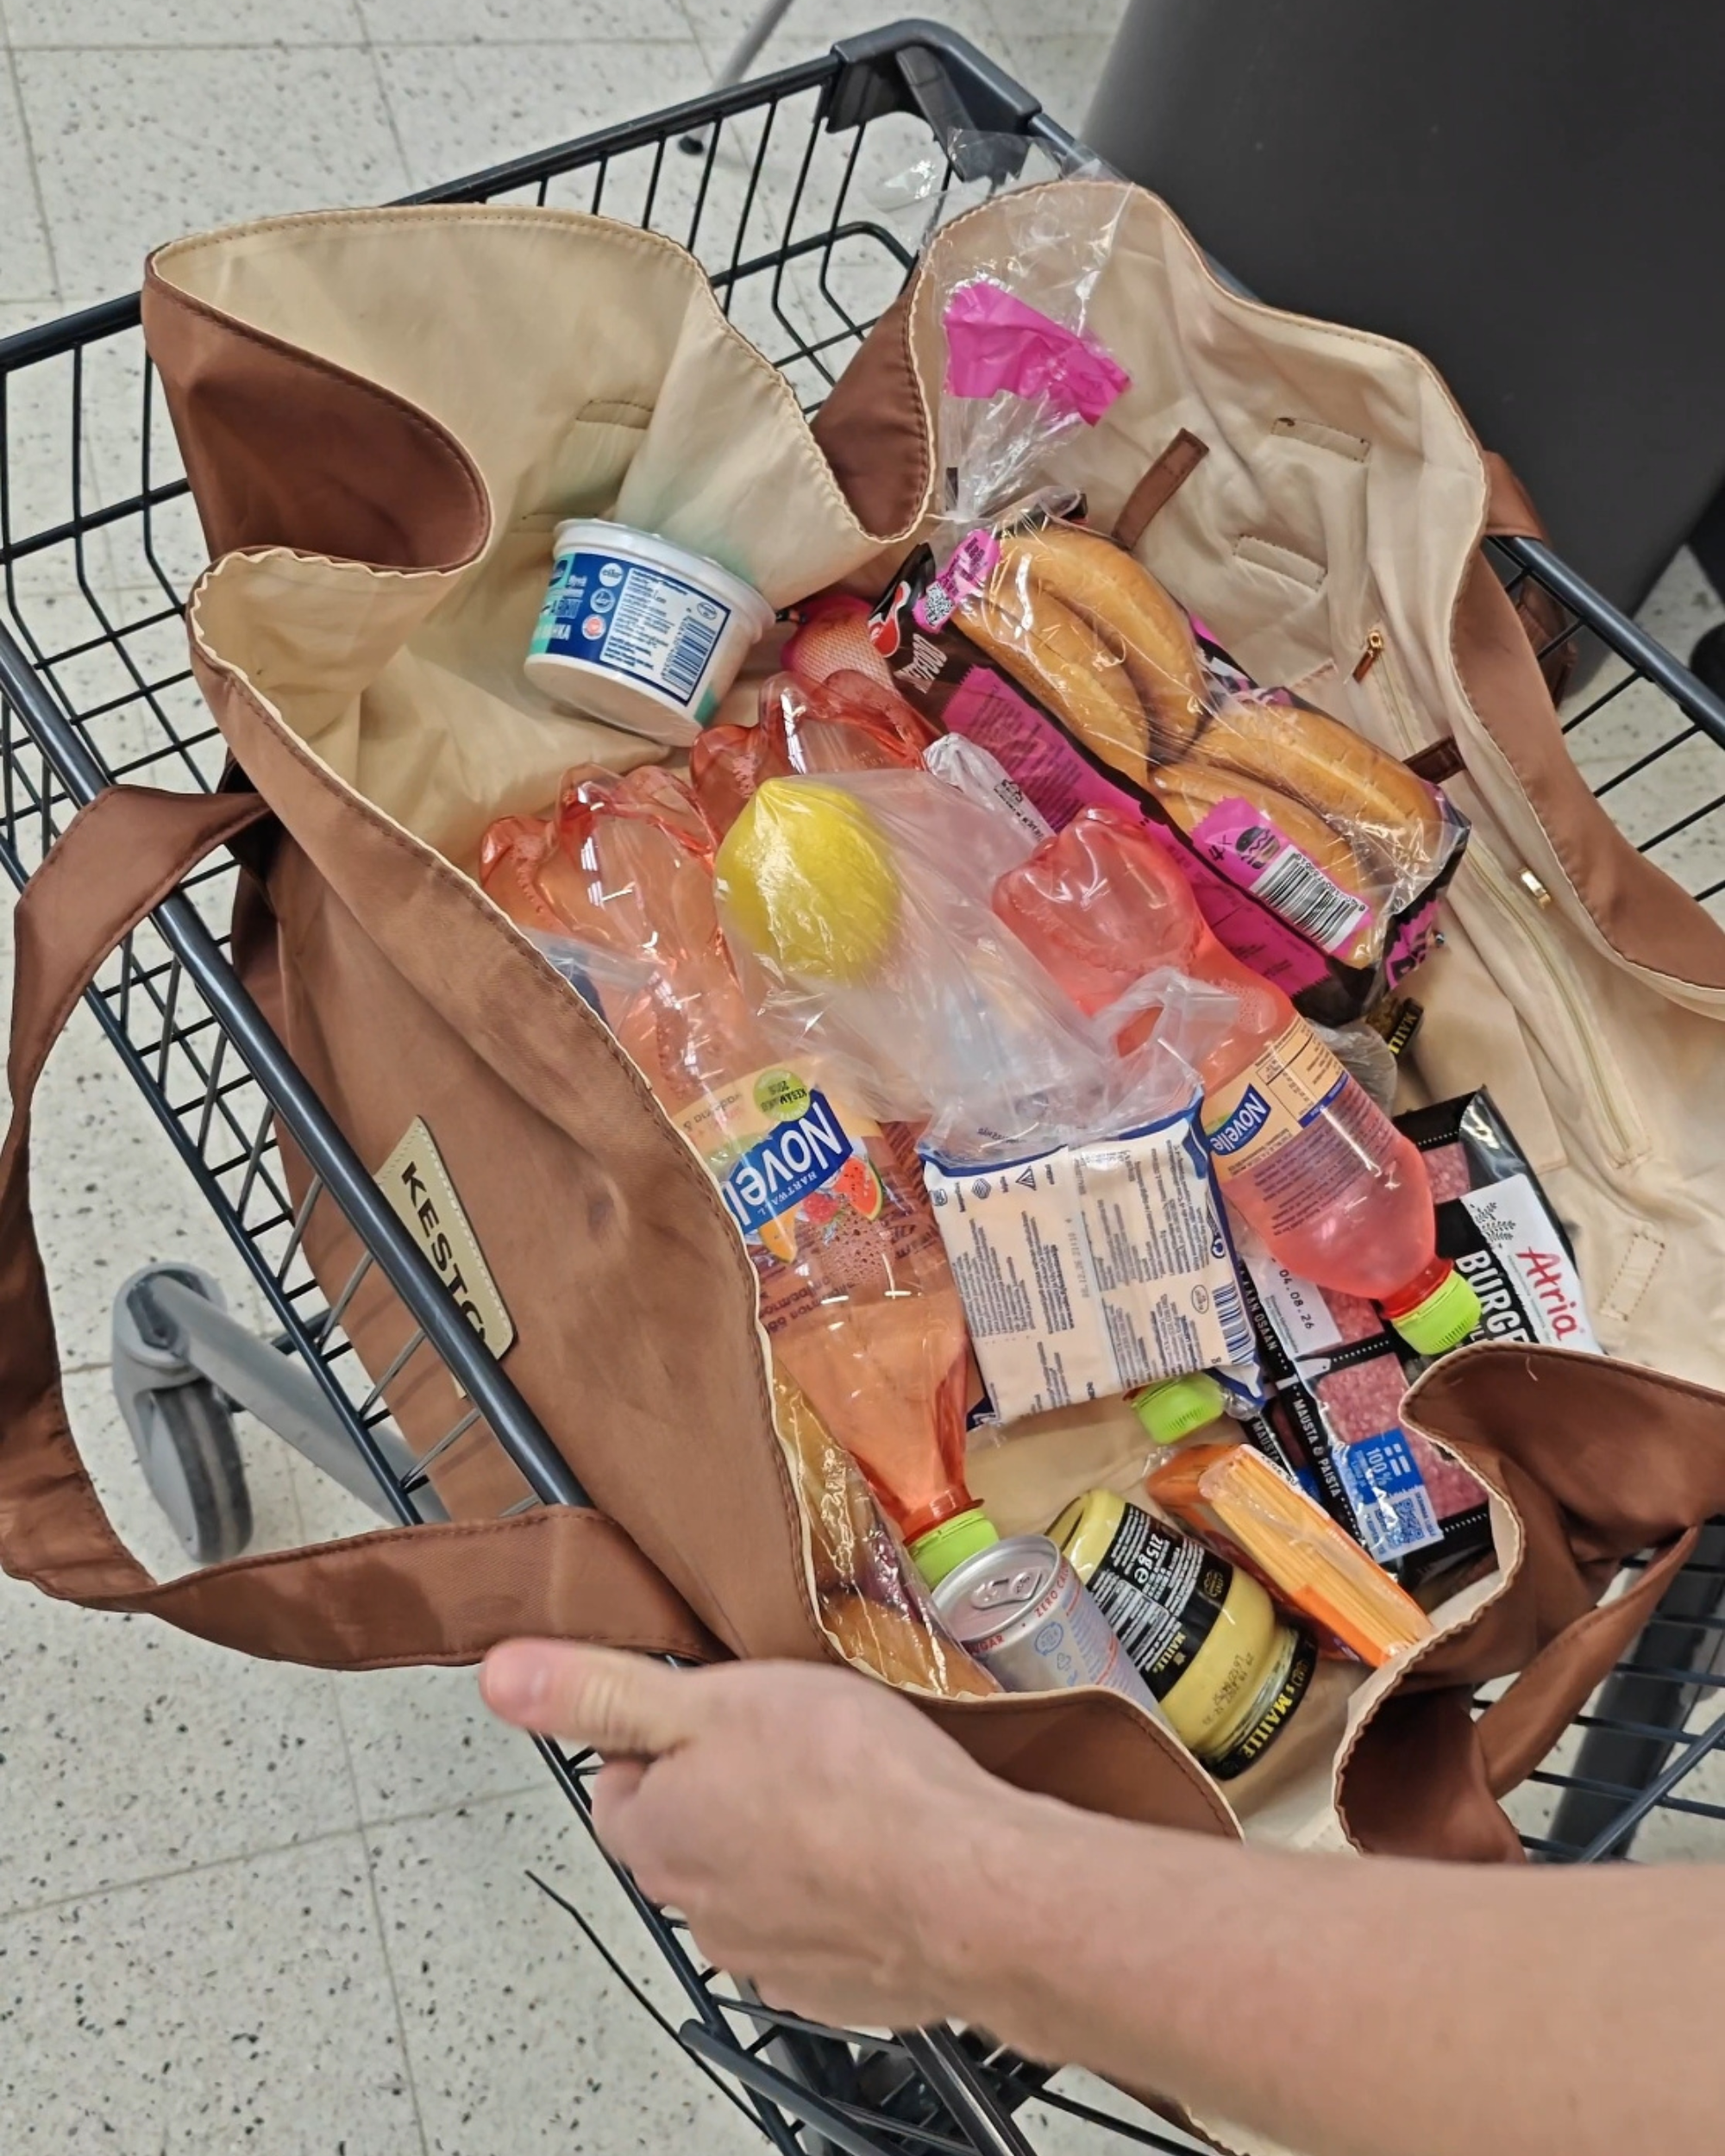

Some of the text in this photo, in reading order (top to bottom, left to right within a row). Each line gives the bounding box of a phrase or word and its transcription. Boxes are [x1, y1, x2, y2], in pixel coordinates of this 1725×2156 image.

[1211, 1094, 1267, 1151] Novelle
[1278, 1269, 1314, 1330] 04.08.26
[1517, 1246, 1578, 1341] Atria
[1293, 1398, 1316, 1451] MAUSTA
[1317, 1457, 1342, 1498] PAISTA
[1035, 1590, 1060, 1618] ZERO
[1240, 1691, 1295, 1758] MAILLE
